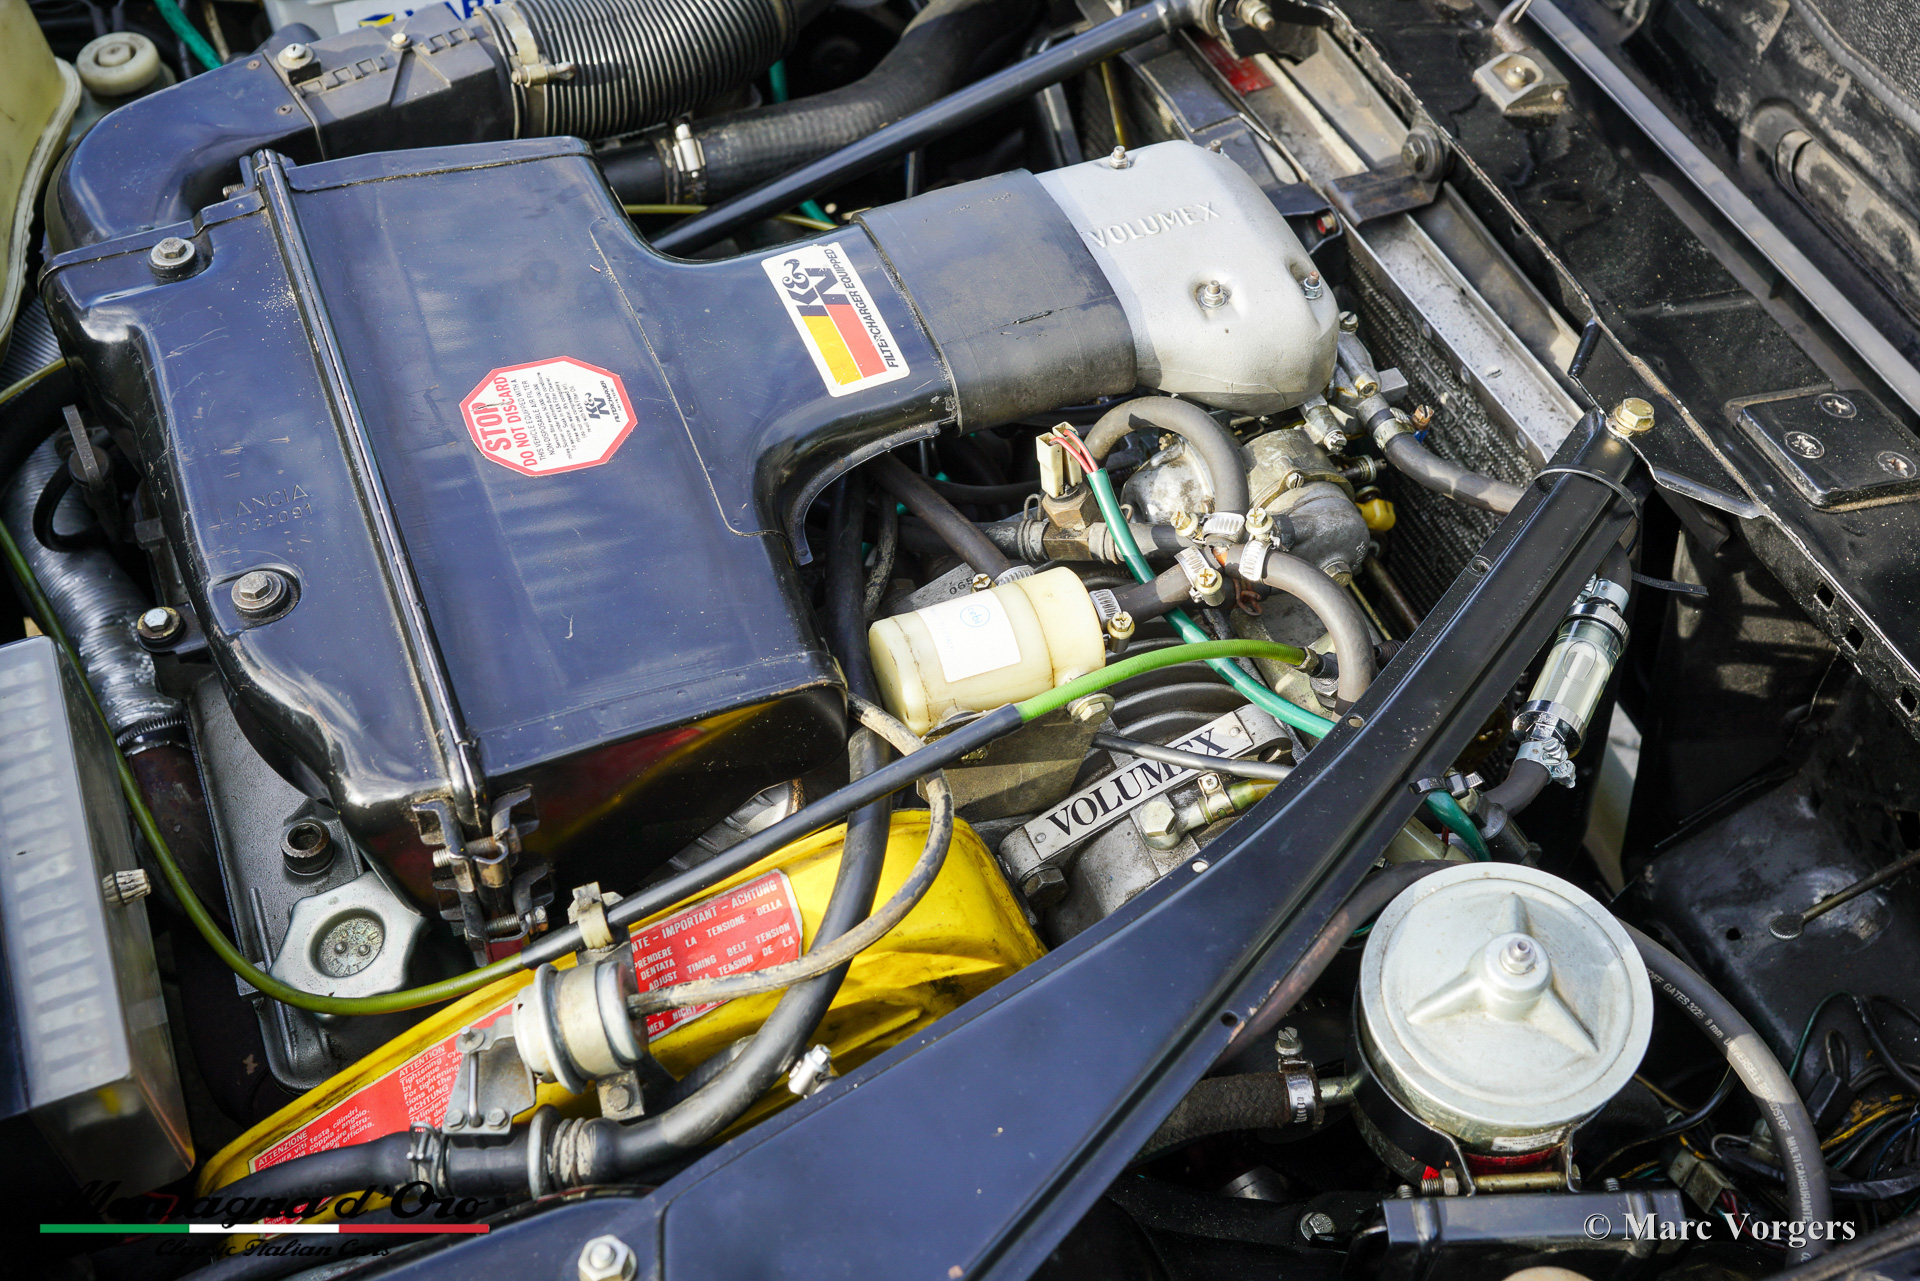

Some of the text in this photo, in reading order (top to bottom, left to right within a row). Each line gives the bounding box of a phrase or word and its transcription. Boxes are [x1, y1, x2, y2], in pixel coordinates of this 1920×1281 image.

[1087, 201, 1219, 248] VOLUMEX
[783, 259, 850, 315] K&N
[824, 248, 898, 367] FILTERCHARGER EQUIPPED
[512, 384, 522, 396] WITH
[584, 392, 610, 418] K&N
[470, 402, 512, 451] STOP
[493, 377, 537, 465] DO NOT DISCARD
[517, 397, 532, 423] EQUIPPED
[521, 380, 555, 454] NON-DISPOSABLE AIR FILTER
[527, 424, 541, 446] VEHICLE
[536, 448, 546, 460] THIS
[216, 484, 307, 521] LANCIA
[223, 502, 312, 538] 7032091
[948, 573, 975, 594] 065
[662, 905, 717, 938] IMPORTANT
[731, 879, 777, 908] ACHTUNG
[685, 936, 697, 948] LA
[706, 914, 745, 937] TENSIONE
[756, 898, 782, 915] DELLA
[640, 958, 675, 980] DENTATA
[649, 922, 790, 990] ADJUST TIMING BELT TENSION
[718, 954, 753, 975] TENSION
[762, 944, 773, 956] DE
[782, 936, 794, 947] LA
[399, 1045, 445, 1078] ATTENTION
[400, 1058, 442, 1087] Tightening
[403, 1084, 412, 1092] by
[416, 1066, 439, 1085] torque
[1663, 983, 1690, 1006] GATES
[1709, 1024, 1724, 1038] mm
[1723, 1038, 1761, 1084] UNIVERSELE
[1757, 1081, 1791, 1132] BRANDSTOF
[1785, 1136, 1802, 1162] MULTI
[404, 1064, 460, 1100] For tightening
[406, 1075, 451, 1106] tions in the
[408, 1084, 448, 1114] ACHTUNG
[410, 1095, 451, 1124] Zylinderko
[258, 1130, 308, 1167] ATTENZIONE
[294, 1142, 307, 1154] viti
[310, 1128, 330, 1144] testa
[333, 1107, 357, 1128] cilindri
[309, 1132, 334, 1151] coppia
[342, 1110, 370, 1129] angolo.
[321, 1130, 347, 1152] seguire
[350, 1117, 370, 1131] istru-
[343, 1122, 374, 1143] officina.
